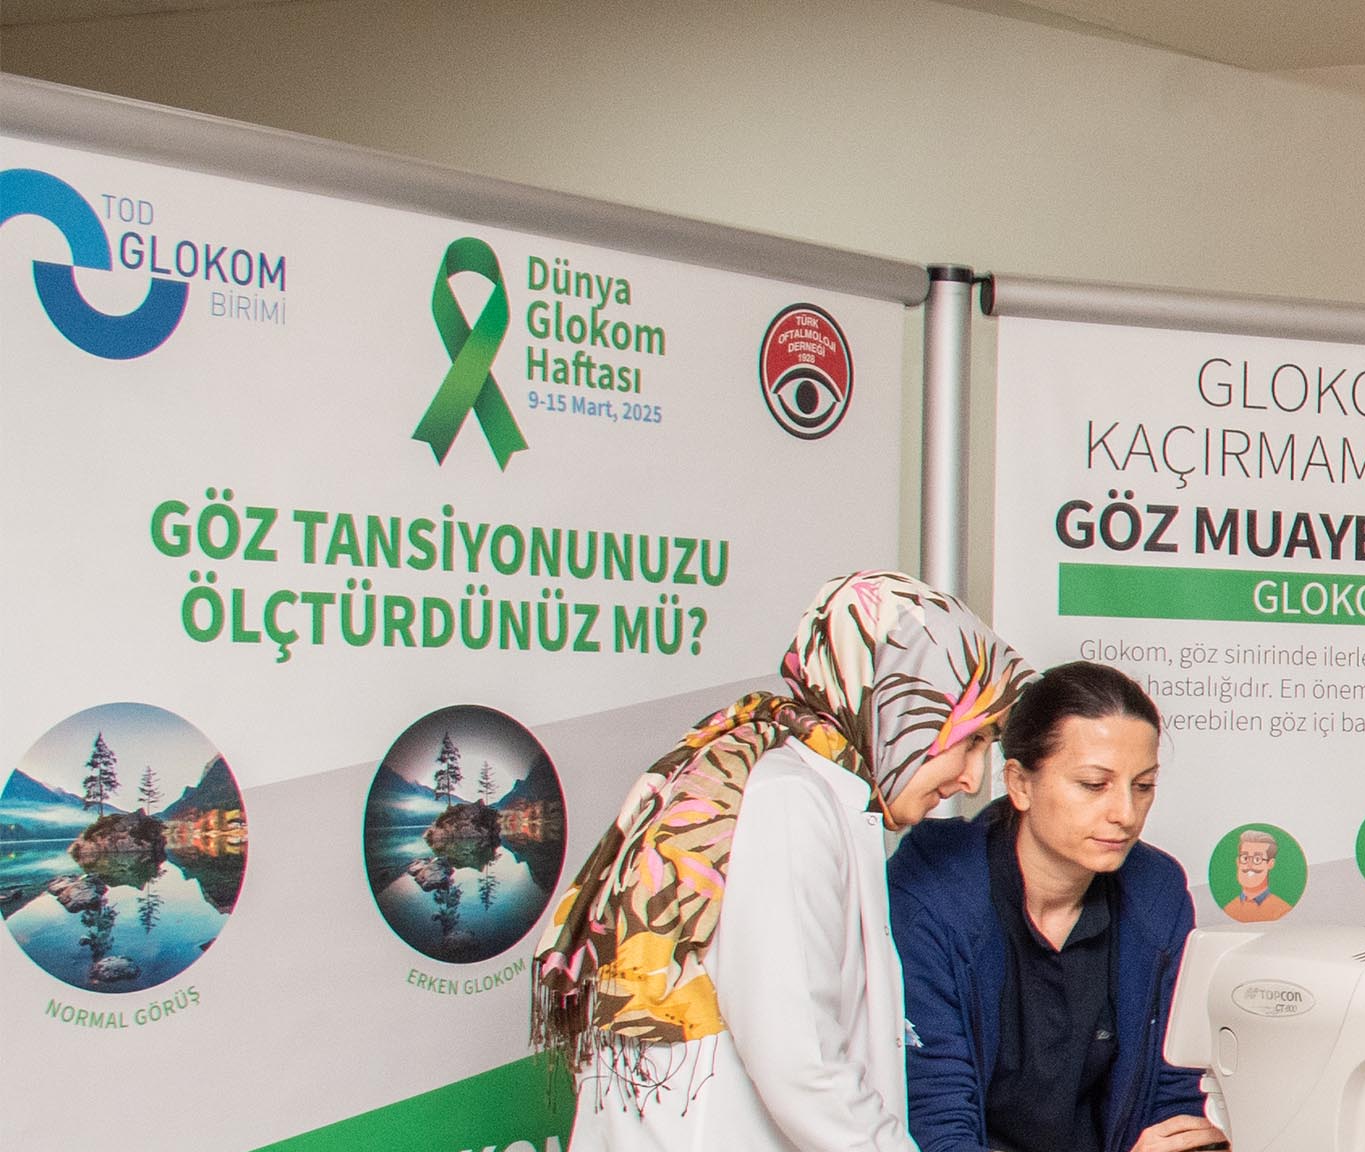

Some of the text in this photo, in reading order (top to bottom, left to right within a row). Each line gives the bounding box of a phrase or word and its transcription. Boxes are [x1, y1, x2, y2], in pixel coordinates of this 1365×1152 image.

[102, 193, 154, 227] TOD
[118, 231, 287, 292] GLOKOM
[527, 255, 632, 307] Dünya
[210, 291, 287, 326] BİRİMİ
[526, 300, 666, 355] Glokom
[527, 346, 642, 394] Haftası
[527, 390, 663, 424] 9-15 Mart, 2025
[150, 486, 731, 587] GÖZ TANSİYONUNUZU
[1055, 488, 1179, 553] GÖZ
[181, 570, 707, 663] ÖLÇTÜRDÜNÜZ MÜ?
[1080, 639, 1173, 666] Glokom,
[1180, 643, 1218, 669] göz
[1224, 644, 1317, 666] sinirinde
[1148, 674, 1273, 703] hastalığıdır.
[1280, 678, 1306, 699] En
[1161, 708, 1262, 731] verebilen
[1269, 712, 1306, 737] göz
[1313, 711, 1335, 738] içi
[405, 957, 527, 995] ERKEN GLOKOM
[45, 985, 202, 1029] NORMAL GÖRÜŞ
